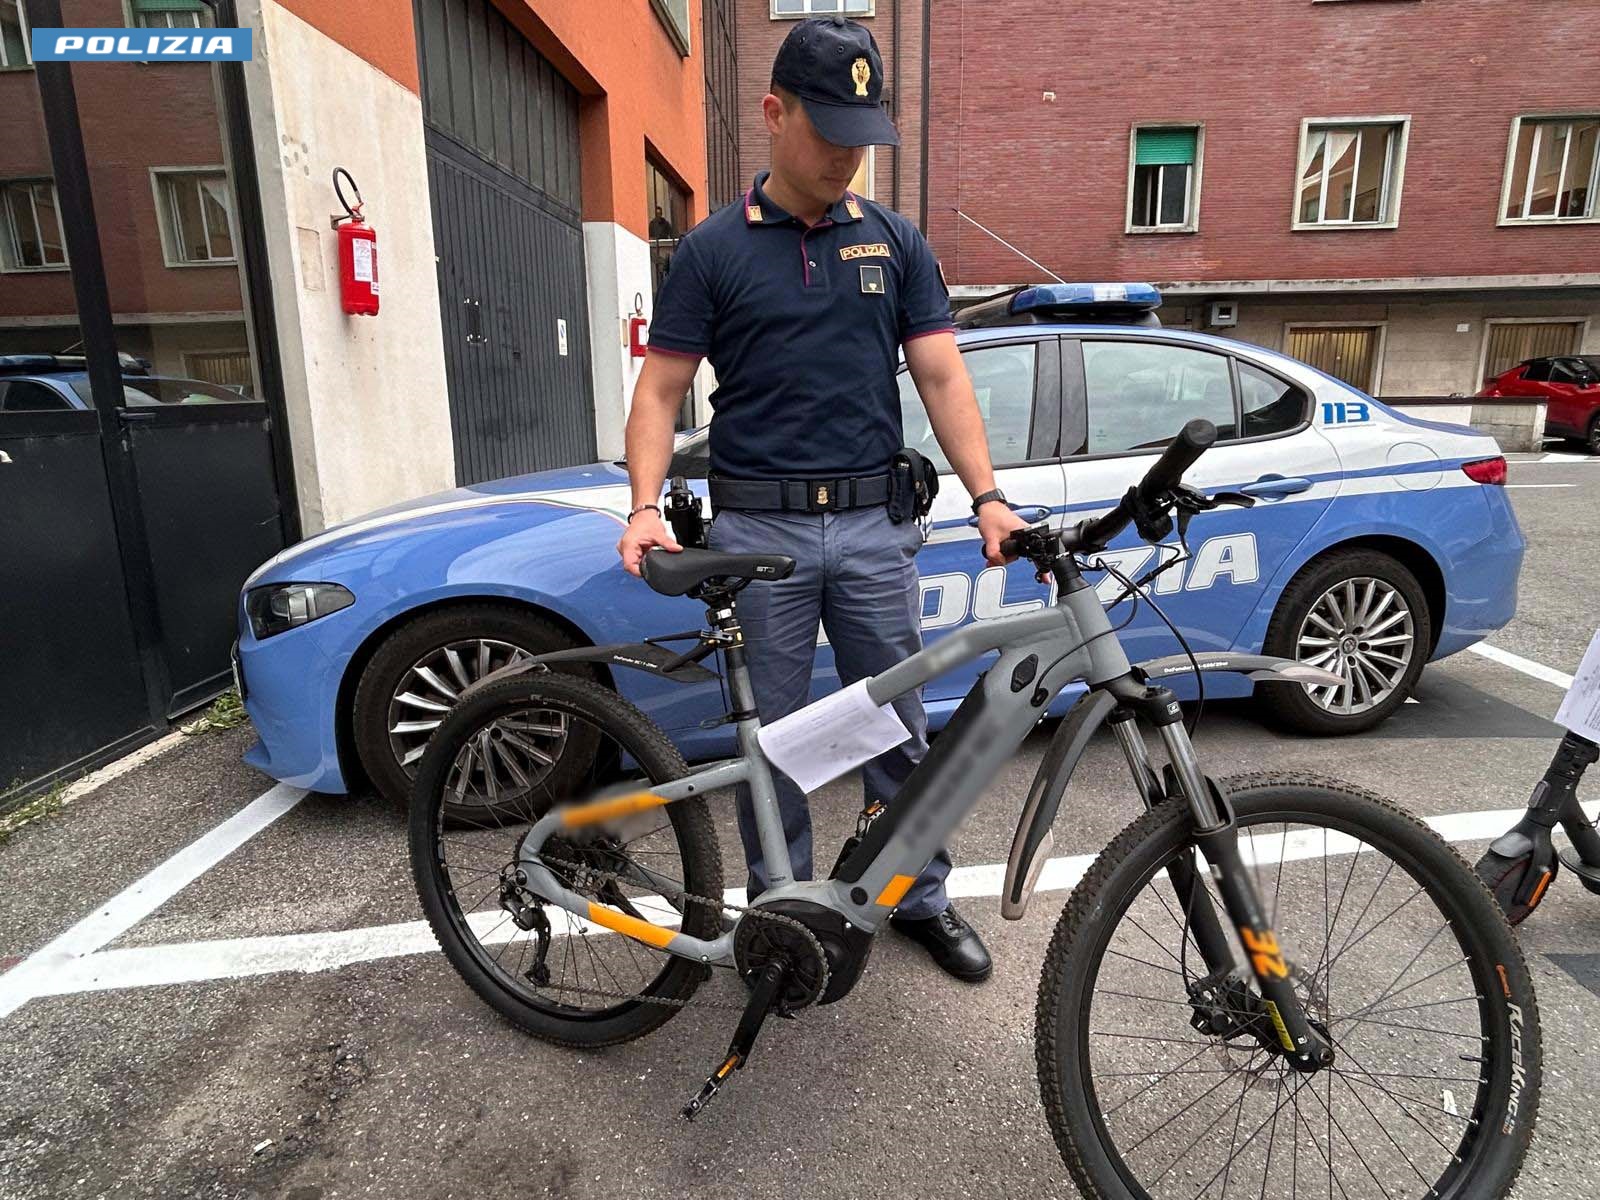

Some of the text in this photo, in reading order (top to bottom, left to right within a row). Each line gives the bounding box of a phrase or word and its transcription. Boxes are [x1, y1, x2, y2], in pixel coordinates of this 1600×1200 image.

[842, 246, 887, 258] POLIZIA
[1321, 402, 1370, 424] 113
[816, 532, 1260, 646] OLZIA
